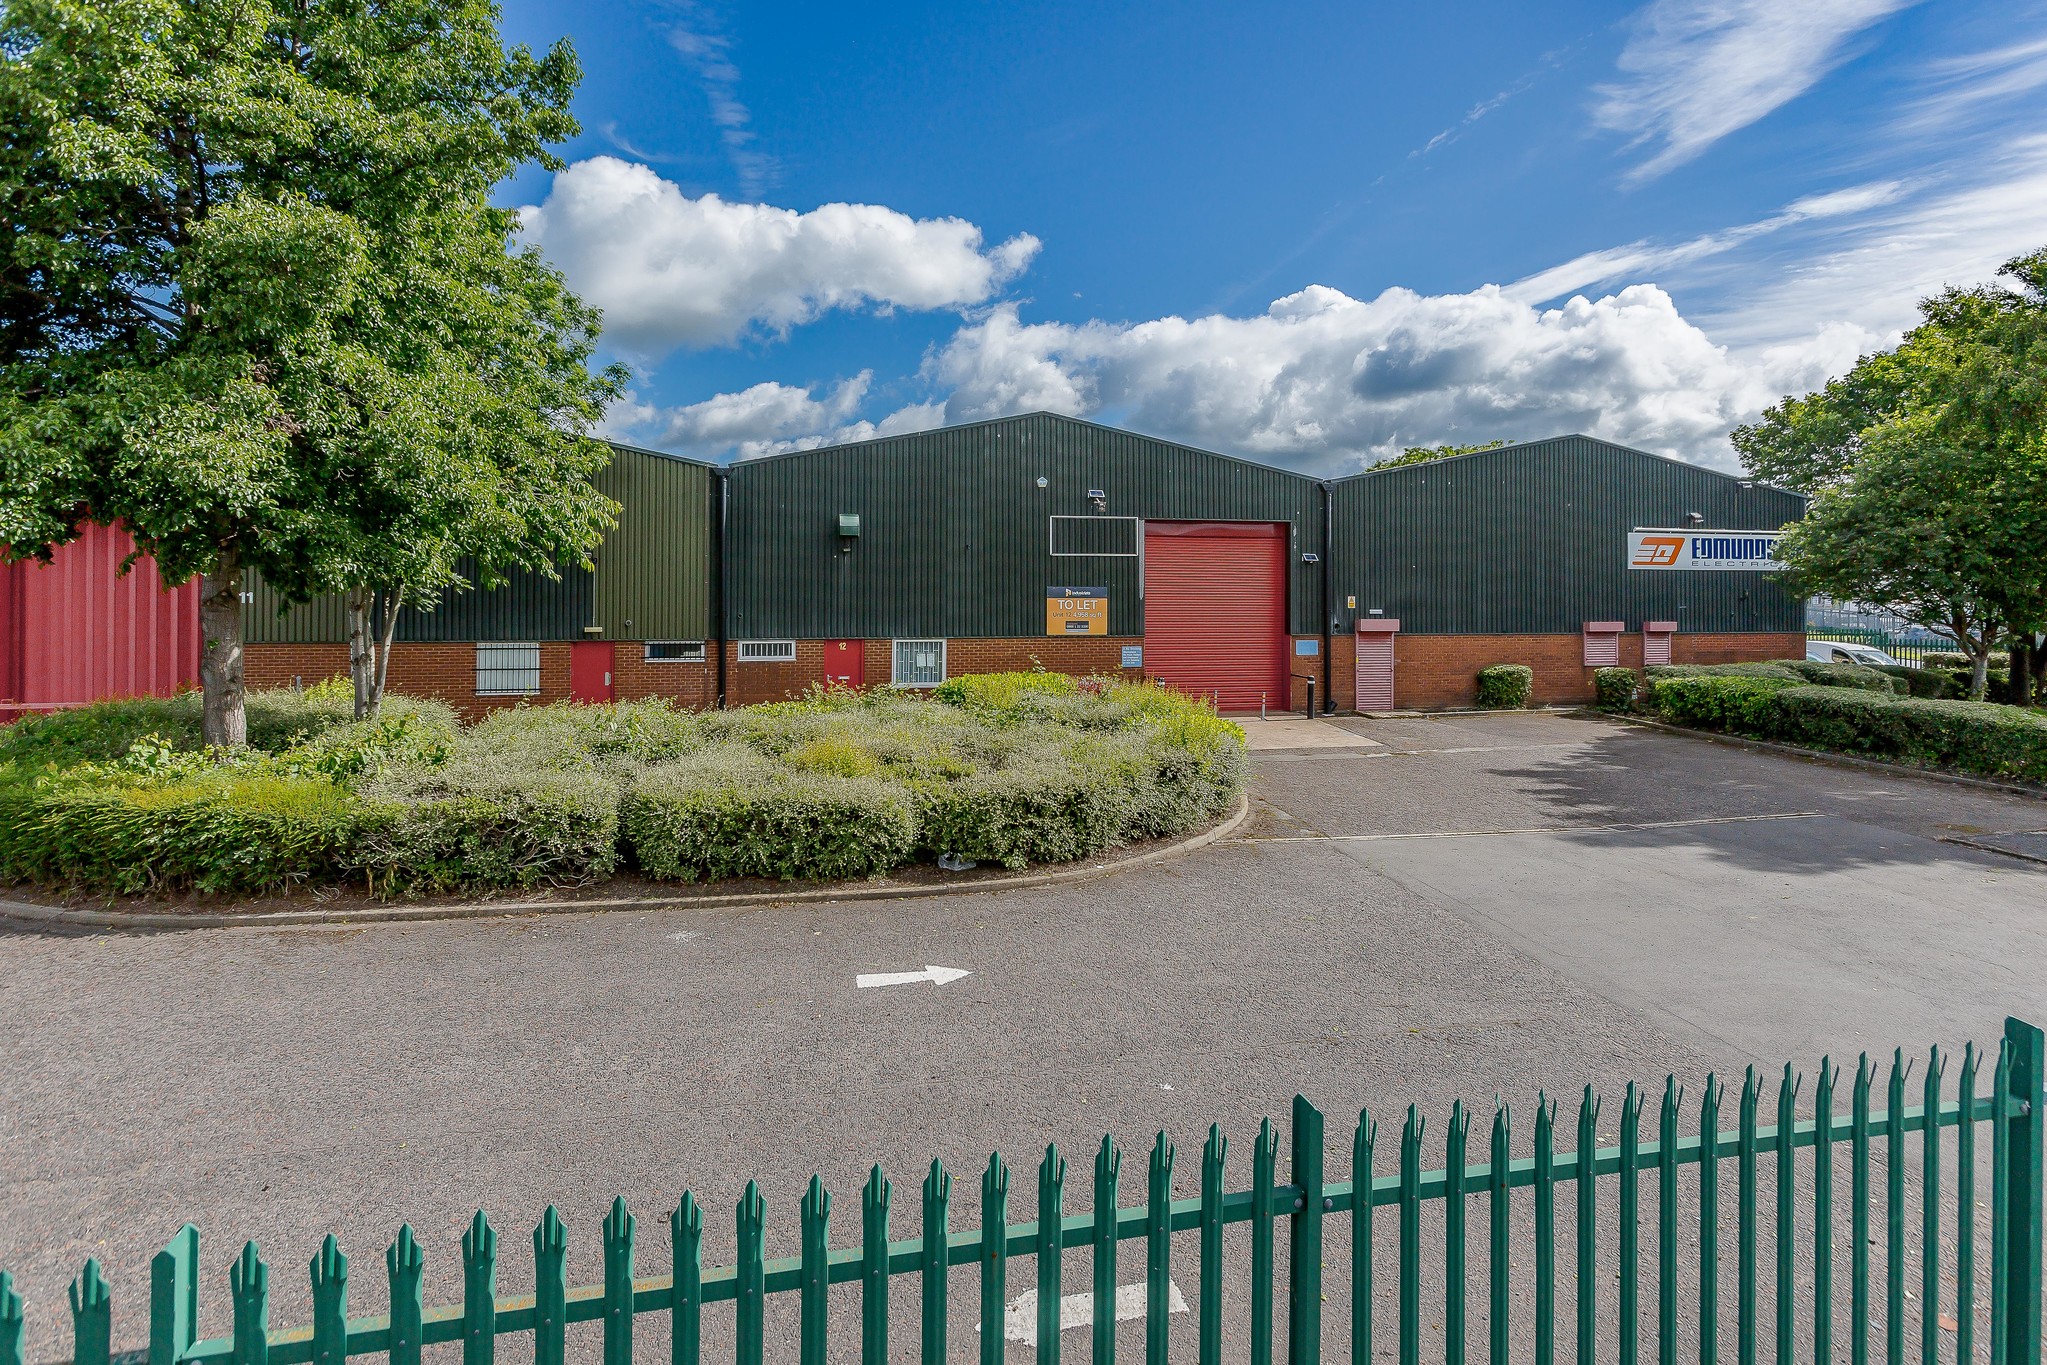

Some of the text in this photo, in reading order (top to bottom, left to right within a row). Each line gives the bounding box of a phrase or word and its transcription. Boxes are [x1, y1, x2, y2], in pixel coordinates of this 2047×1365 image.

[1691, 537, 1785, 560] EDMUNDS
[238, 591, 254, 604] 11
[1057, 599, 1098, 610] TO LET
[838, 642, 847, 651] 12
